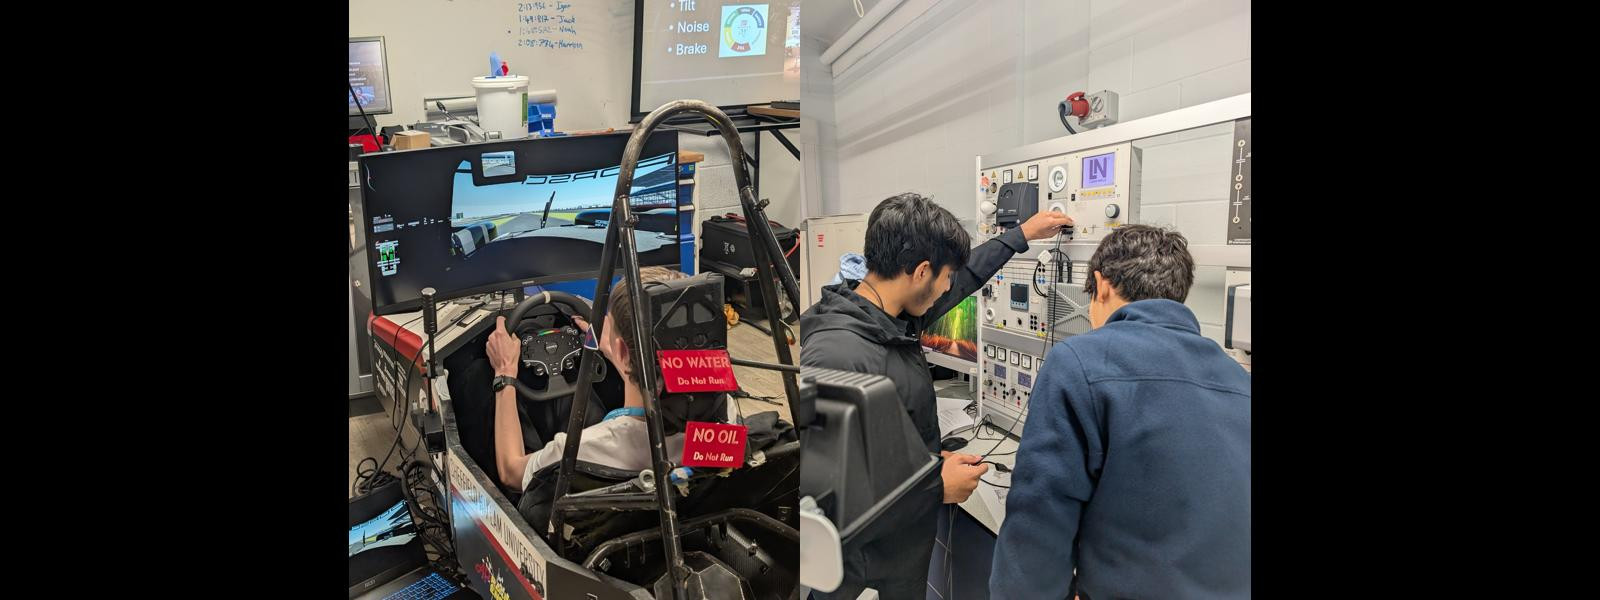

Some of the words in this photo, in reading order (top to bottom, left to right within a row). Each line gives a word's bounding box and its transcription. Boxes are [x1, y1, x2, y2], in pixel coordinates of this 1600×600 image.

[679, 0, 696, 11] Tilt
[677, 21, 710, 33] Noise
[676, 43, 708, 56] Brake
[662, 357, 683, 369] NO
[686, 356, 731, 369] WATER
[677, 377, 690, 386] Do
[691, 377, 707, 385] Not
[708, 376, 725, 385] Run
[693, 428, 715, 443] NO
[717, 430, 739, 444] OIL
[693, 451, 704, 461] Do
[705, 452, 719, 462] Not
[719, 453, 734, 462] Run
